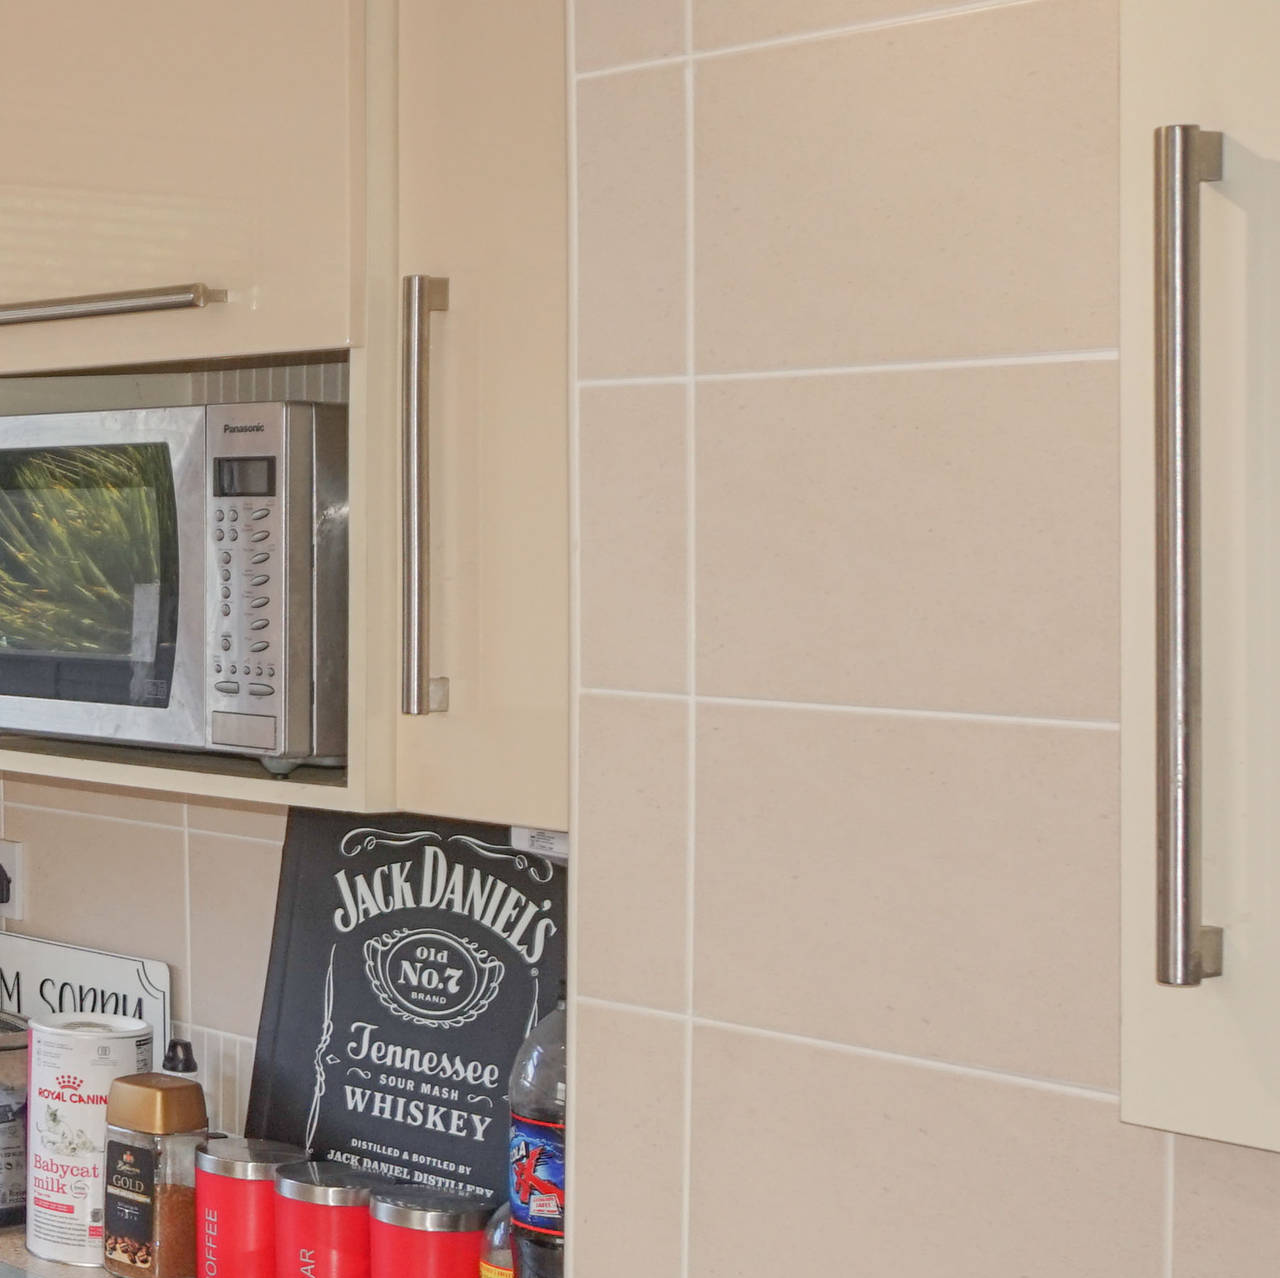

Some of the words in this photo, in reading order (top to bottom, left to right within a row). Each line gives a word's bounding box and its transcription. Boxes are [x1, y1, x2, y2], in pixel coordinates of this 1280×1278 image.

[223, 423, 265, 433] Panasonic
[332, 860, 416, 933] JACK
[422, 844, 558, 964] DANIEL'S
[415, 945, 448, 964] Old
[411, 991, 447, 1005] BRAND
[346, 1021, 500, 1089] Tennessee
[38, 1087, 67, 1103] ROYAL
[69, 1093, 109, 1105] CANIN
[379, 1073, 414, 1093] SOUR
[420, 1081, 460, 1101] MASH
[344, 1085, 494, 1142] WHISKEY
[33, 1153, 100, 1179] Babycat
[327, 1149, 360, 1167] JACK
[362, 1158, 411, 1180] DANIEL
[351, 1138, 400, 1158] DISTILLED
[412, 1153, 456, 1172] BOTTLED
[458, 1164, 472, 1175] BY
[33, 1176, 68, 1195] milk
[112, 1174, 145, 1193] GOLD
